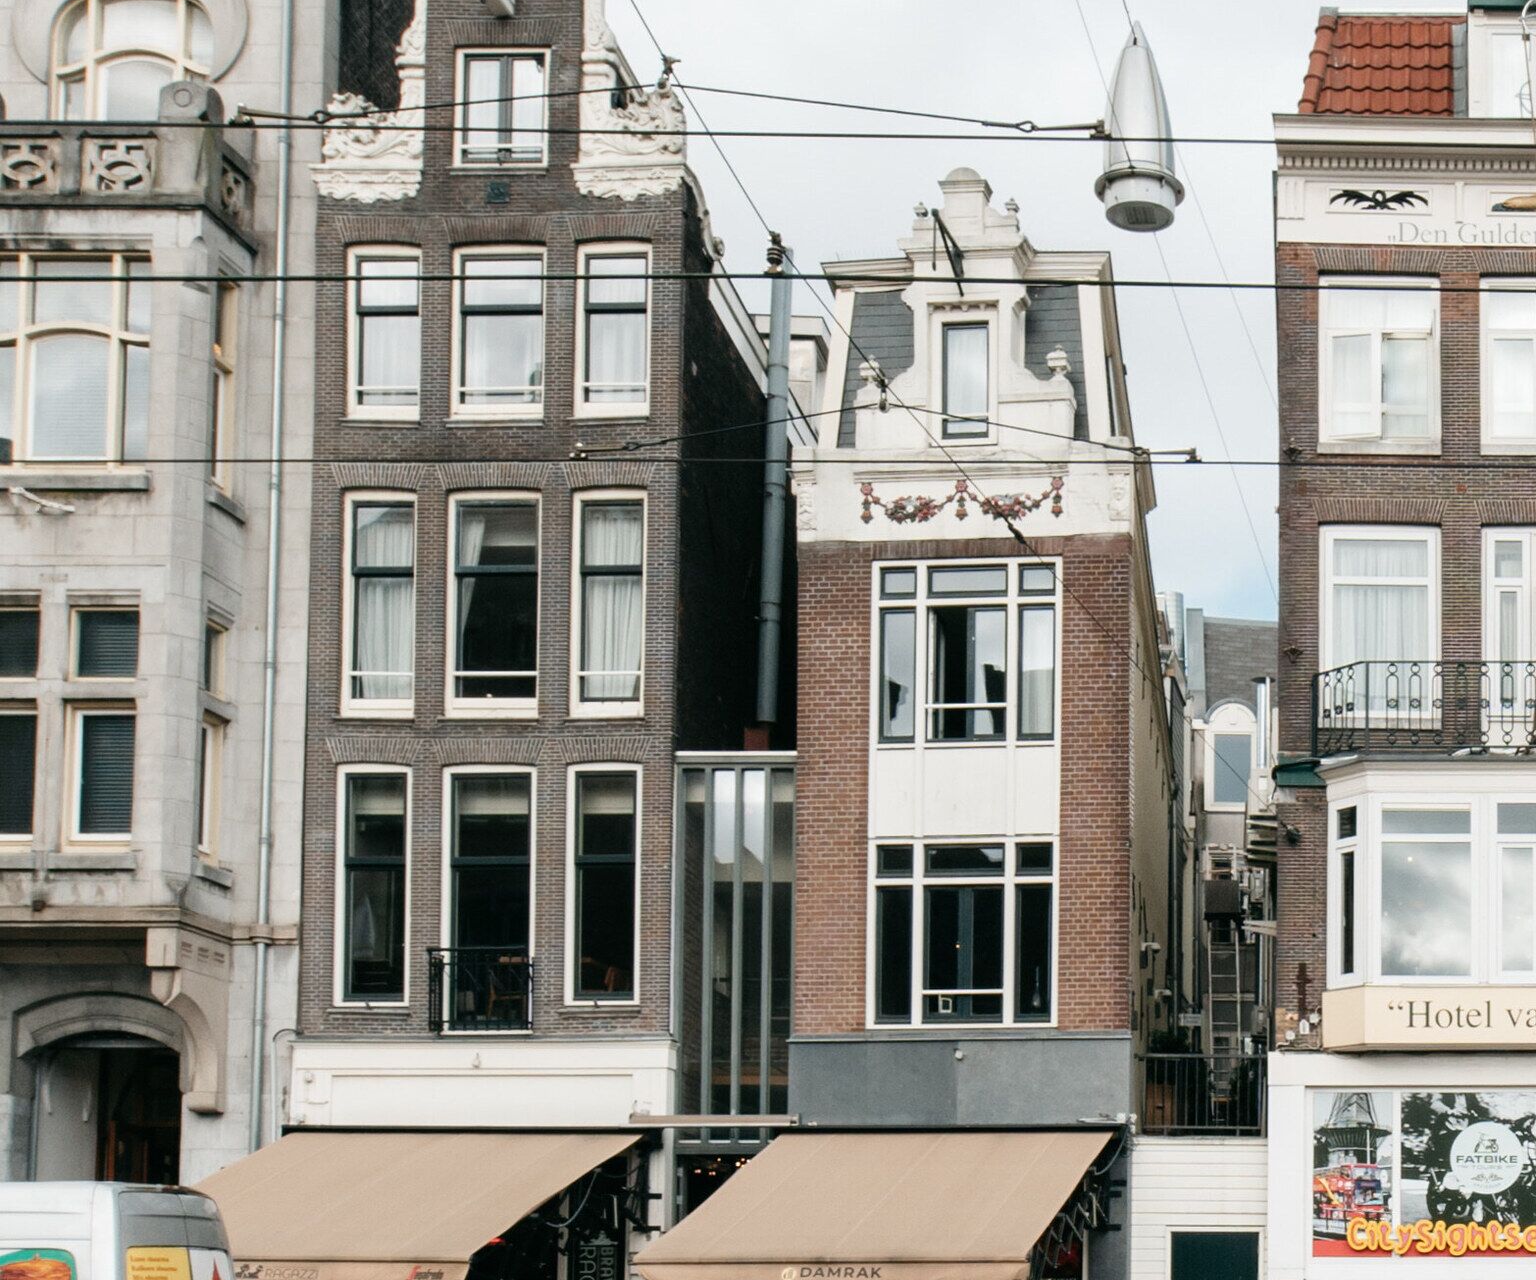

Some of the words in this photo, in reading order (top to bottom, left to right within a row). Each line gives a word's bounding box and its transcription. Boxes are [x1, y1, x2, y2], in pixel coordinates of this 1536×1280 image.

[1456, 1155, 1518, 1164] FATBIKE
[265, 1268, 319, 1279] RAGAZZI
[800, 1267, 882, 1278] DAMRAK
